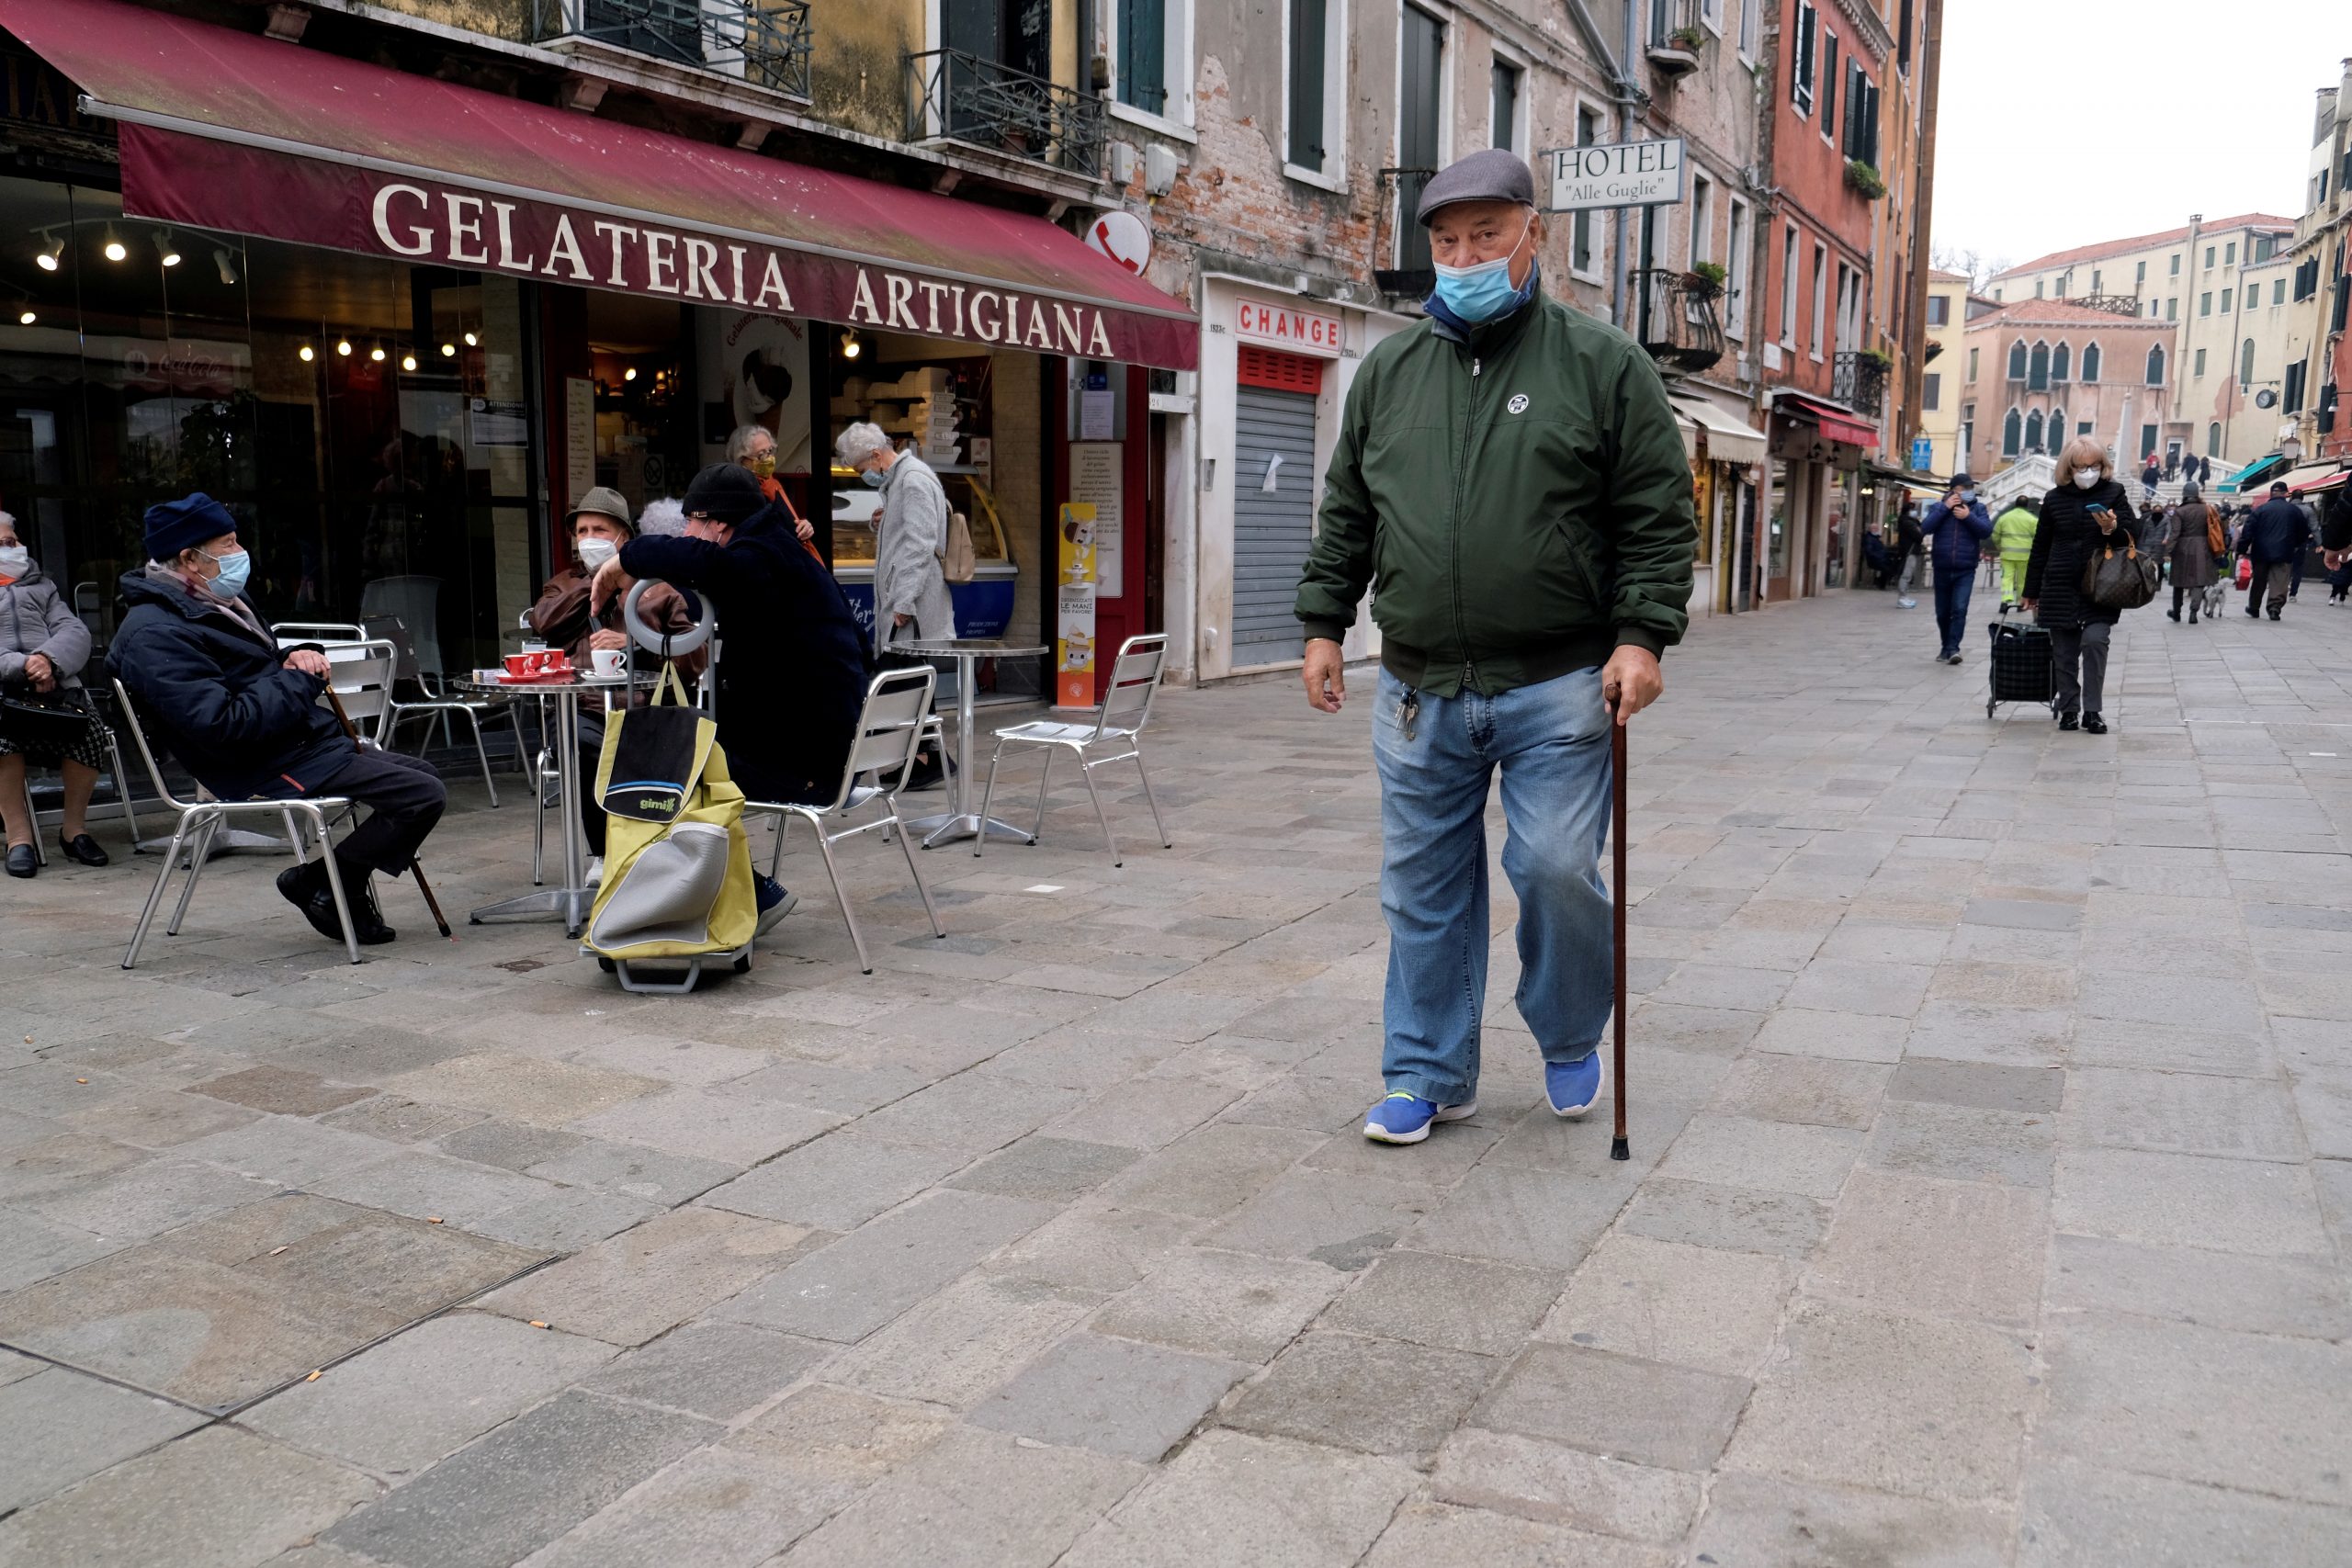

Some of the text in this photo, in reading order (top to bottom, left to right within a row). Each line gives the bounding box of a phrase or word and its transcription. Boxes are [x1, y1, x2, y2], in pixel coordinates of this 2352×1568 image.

[1557, 143, 1677, 180] HOTEL
[1566, 177, 1664, 201] "Alle Guglie"
[372, 184, 1114, 357] GELATERIA ARTIGIANA
[1240, 304, 1338, 346] CHANGE
